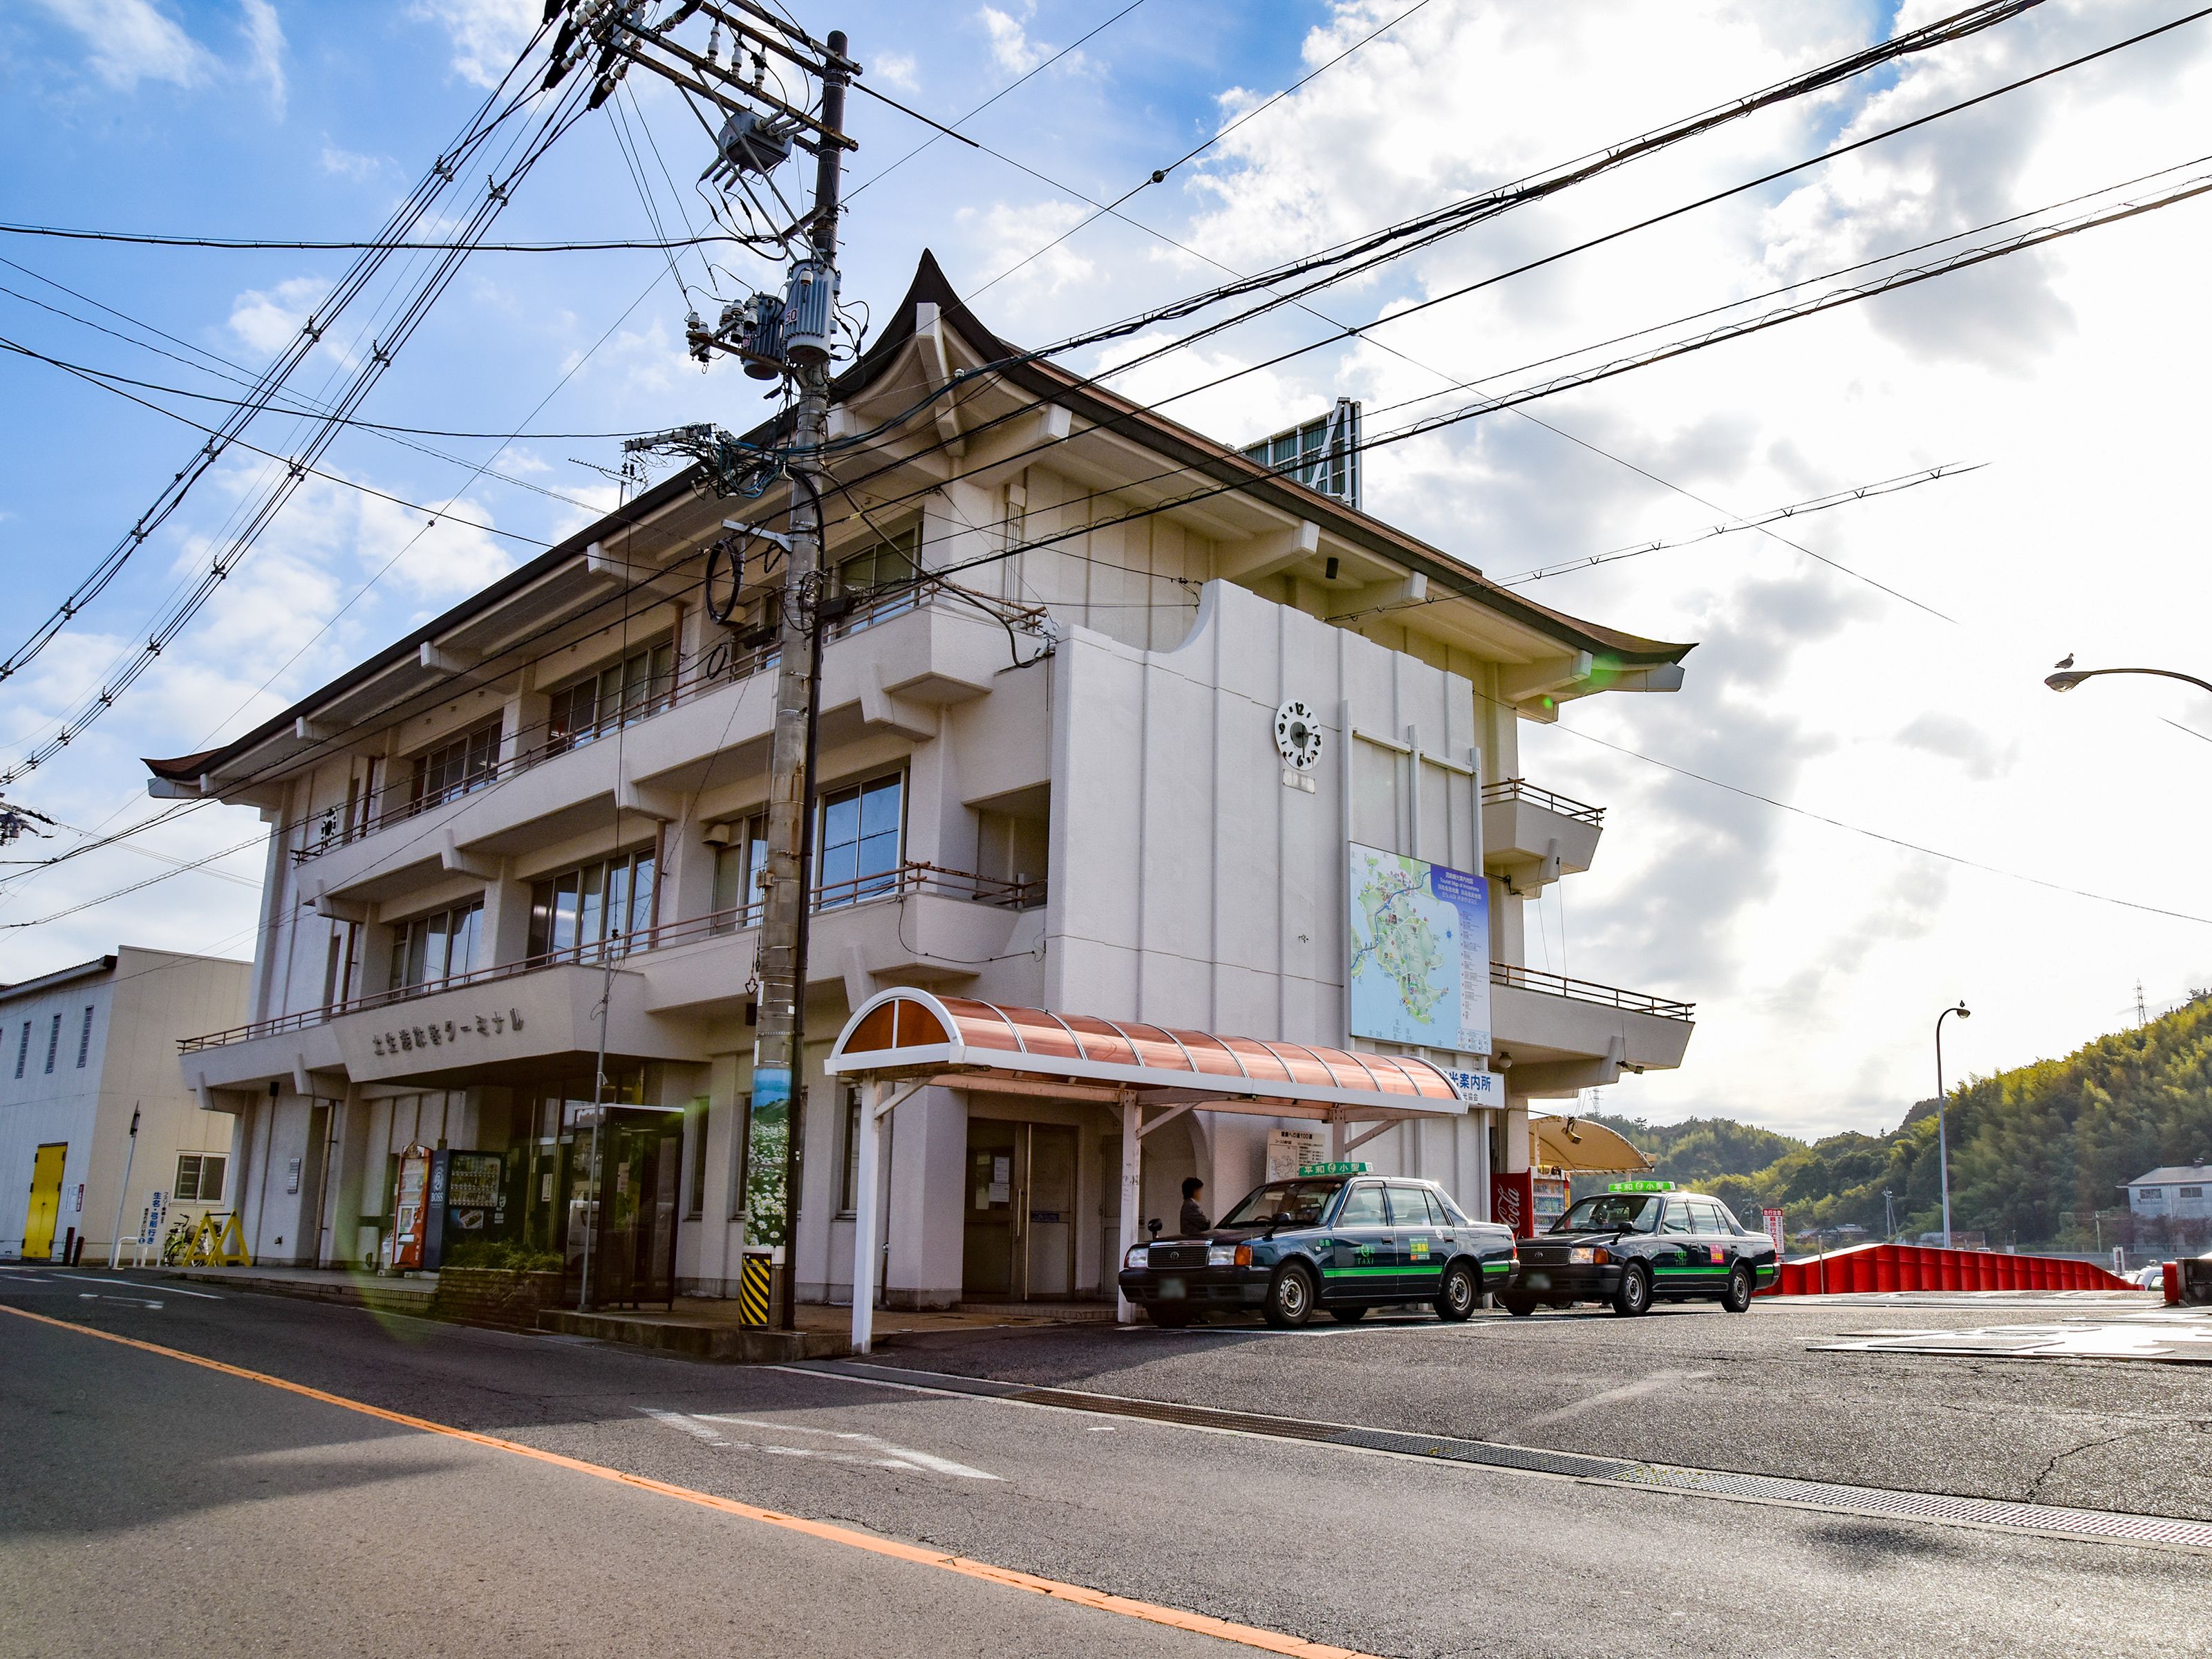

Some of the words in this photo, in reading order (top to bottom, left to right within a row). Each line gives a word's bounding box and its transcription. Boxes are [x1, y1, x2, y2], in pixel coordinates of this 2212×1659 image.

[786, 310, 797, 323] 50
[1295, 702, 1304, 715] 12
[1279, 723, 1285, 734] 9
[1314, 734, 1321, 747] 3
[1297, 755, 1304, 767] 6
[1445, 1071, 1491, 1091] 光案内所
[431, 1192, 444, 1202] BOSS
